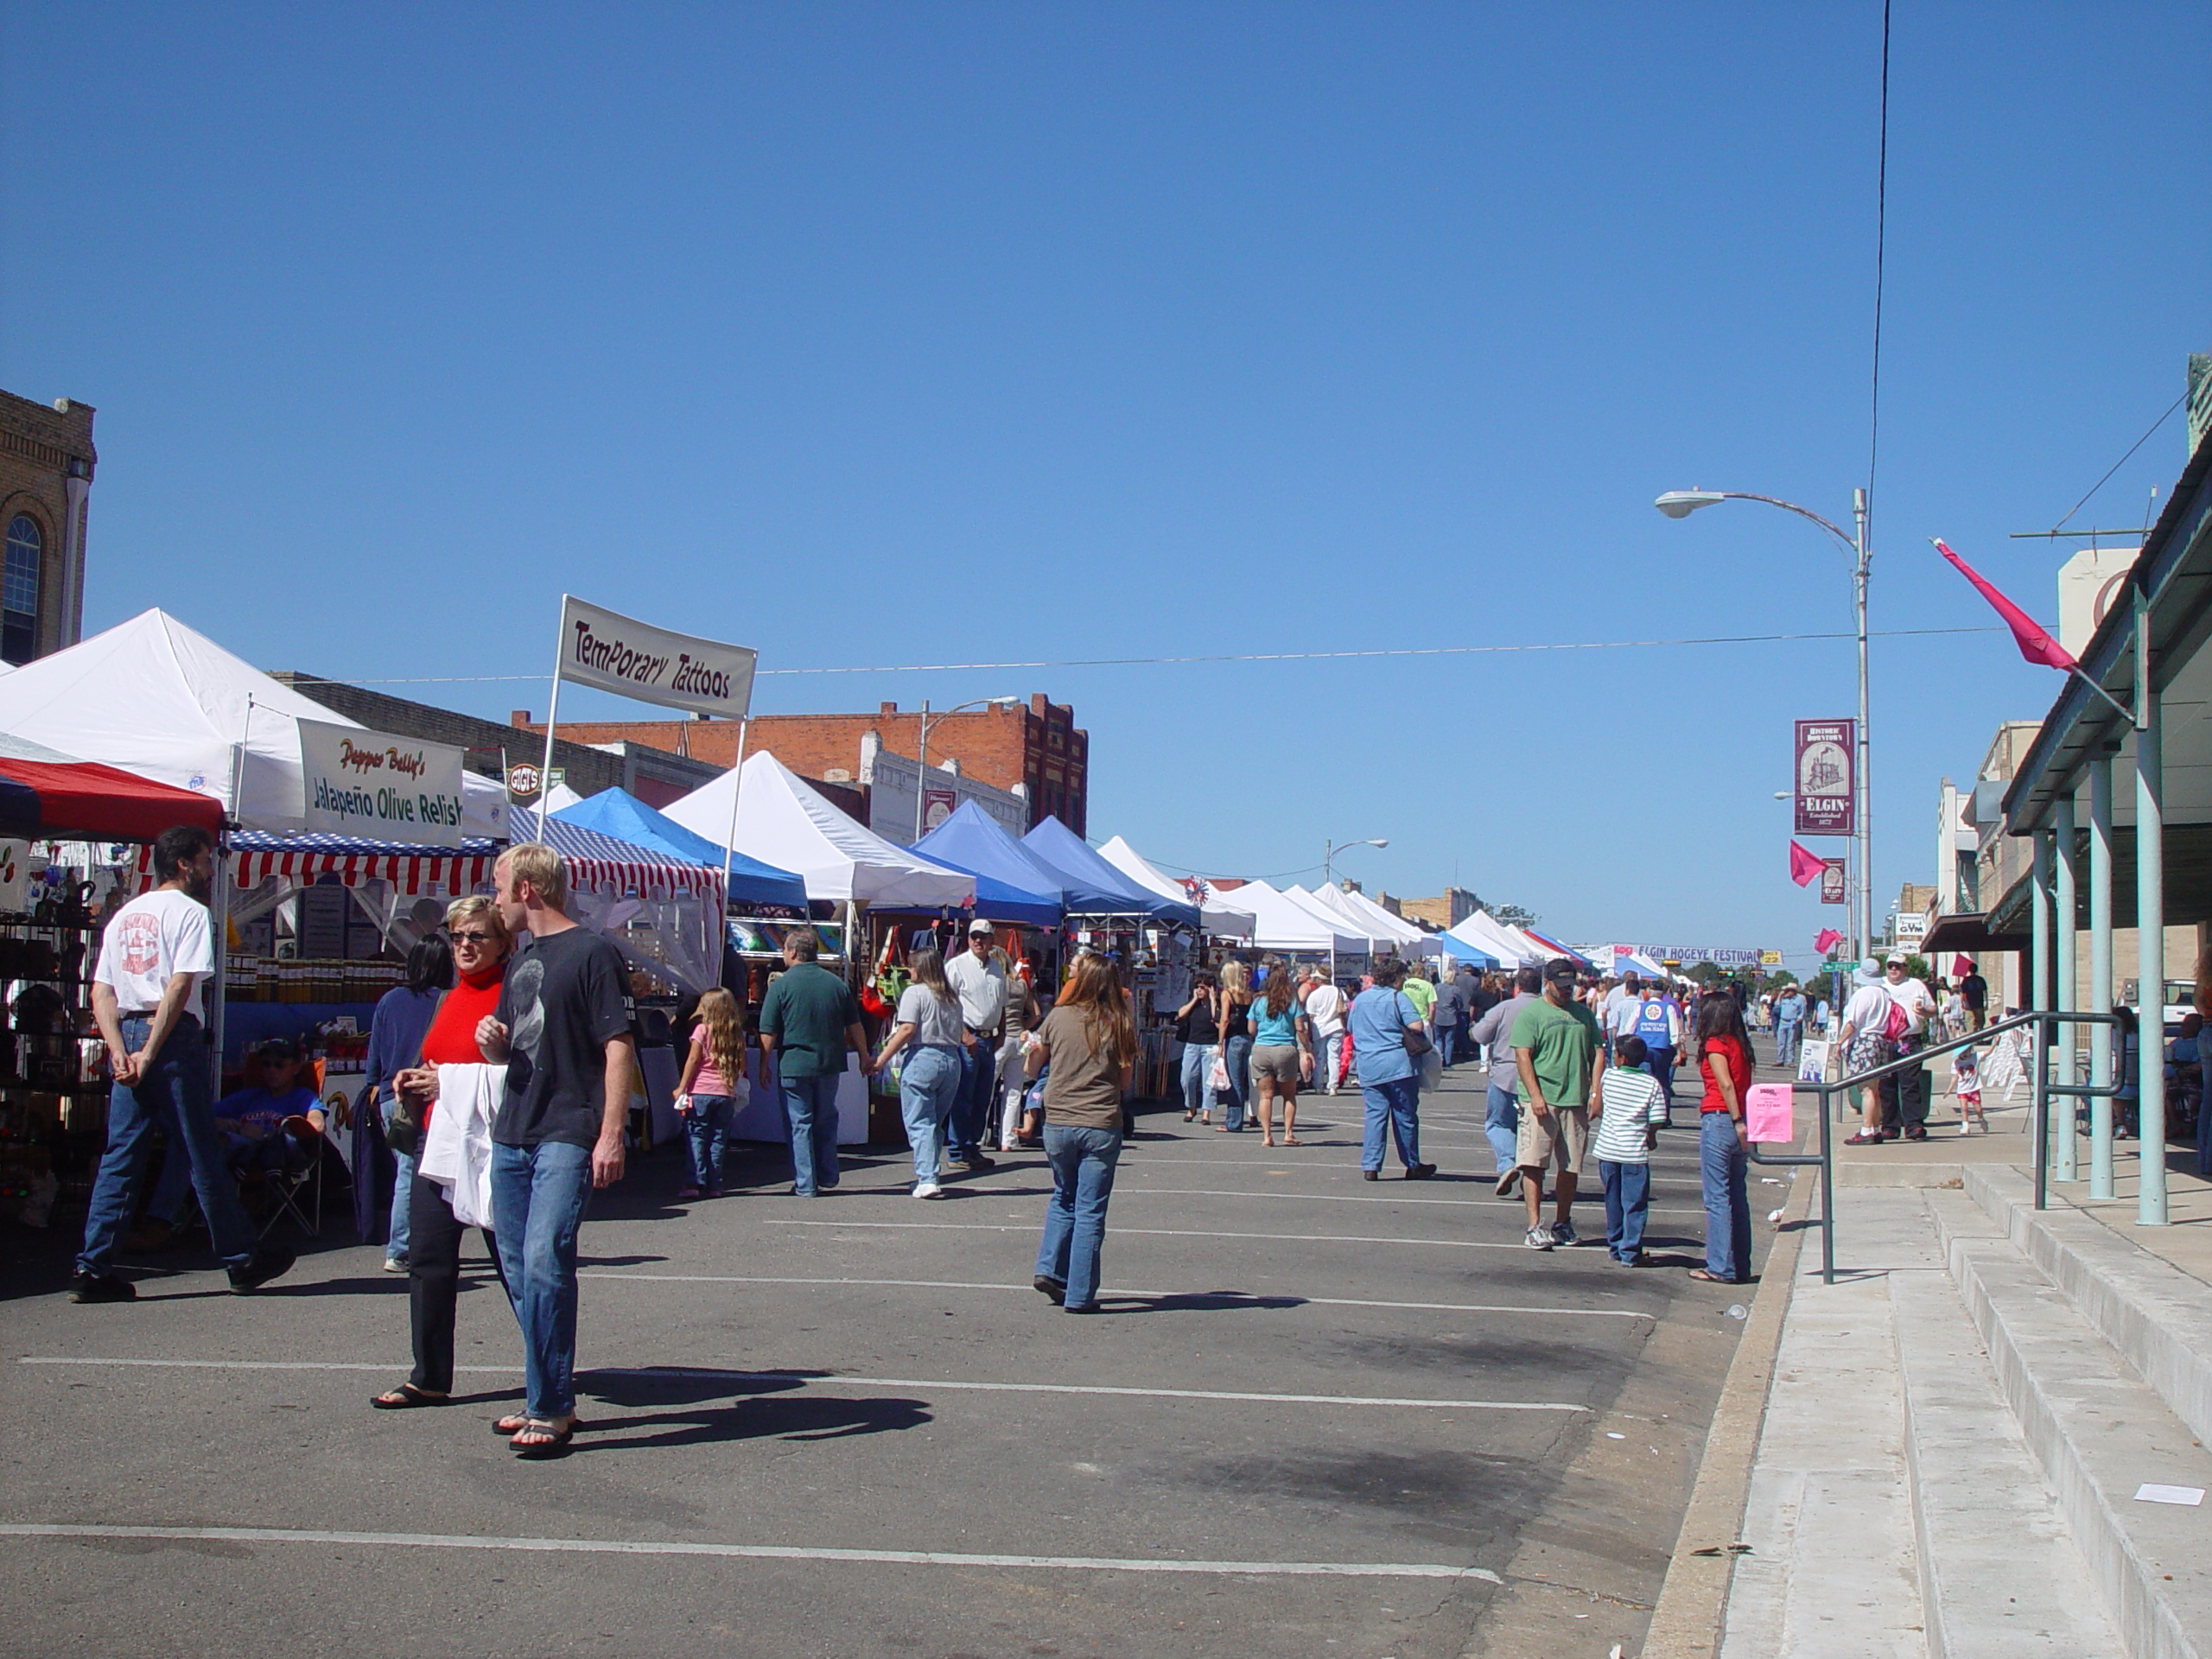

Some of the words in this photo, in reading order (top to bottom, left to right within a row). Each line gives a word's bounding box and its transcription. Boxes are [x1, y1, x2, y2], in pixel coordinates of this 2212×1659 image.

[671, 652, 730, 699] Tattoos
[340, 738, 385, 775] Pepper
[385, 747, 426, 781] Belly's
[314, 777, 373, 821] Jalapeño
[377, 787, 416, 823] Olive
[1806, 797, 1845, 811] ELGIN
[1900, 923, 1923, 932] GYM
[1639, 945, 1666, 958] ELGIN
[1670, 948, 1709, 961] HOGEYE
[1714, 949, 1758, 963] FESTIVAL
